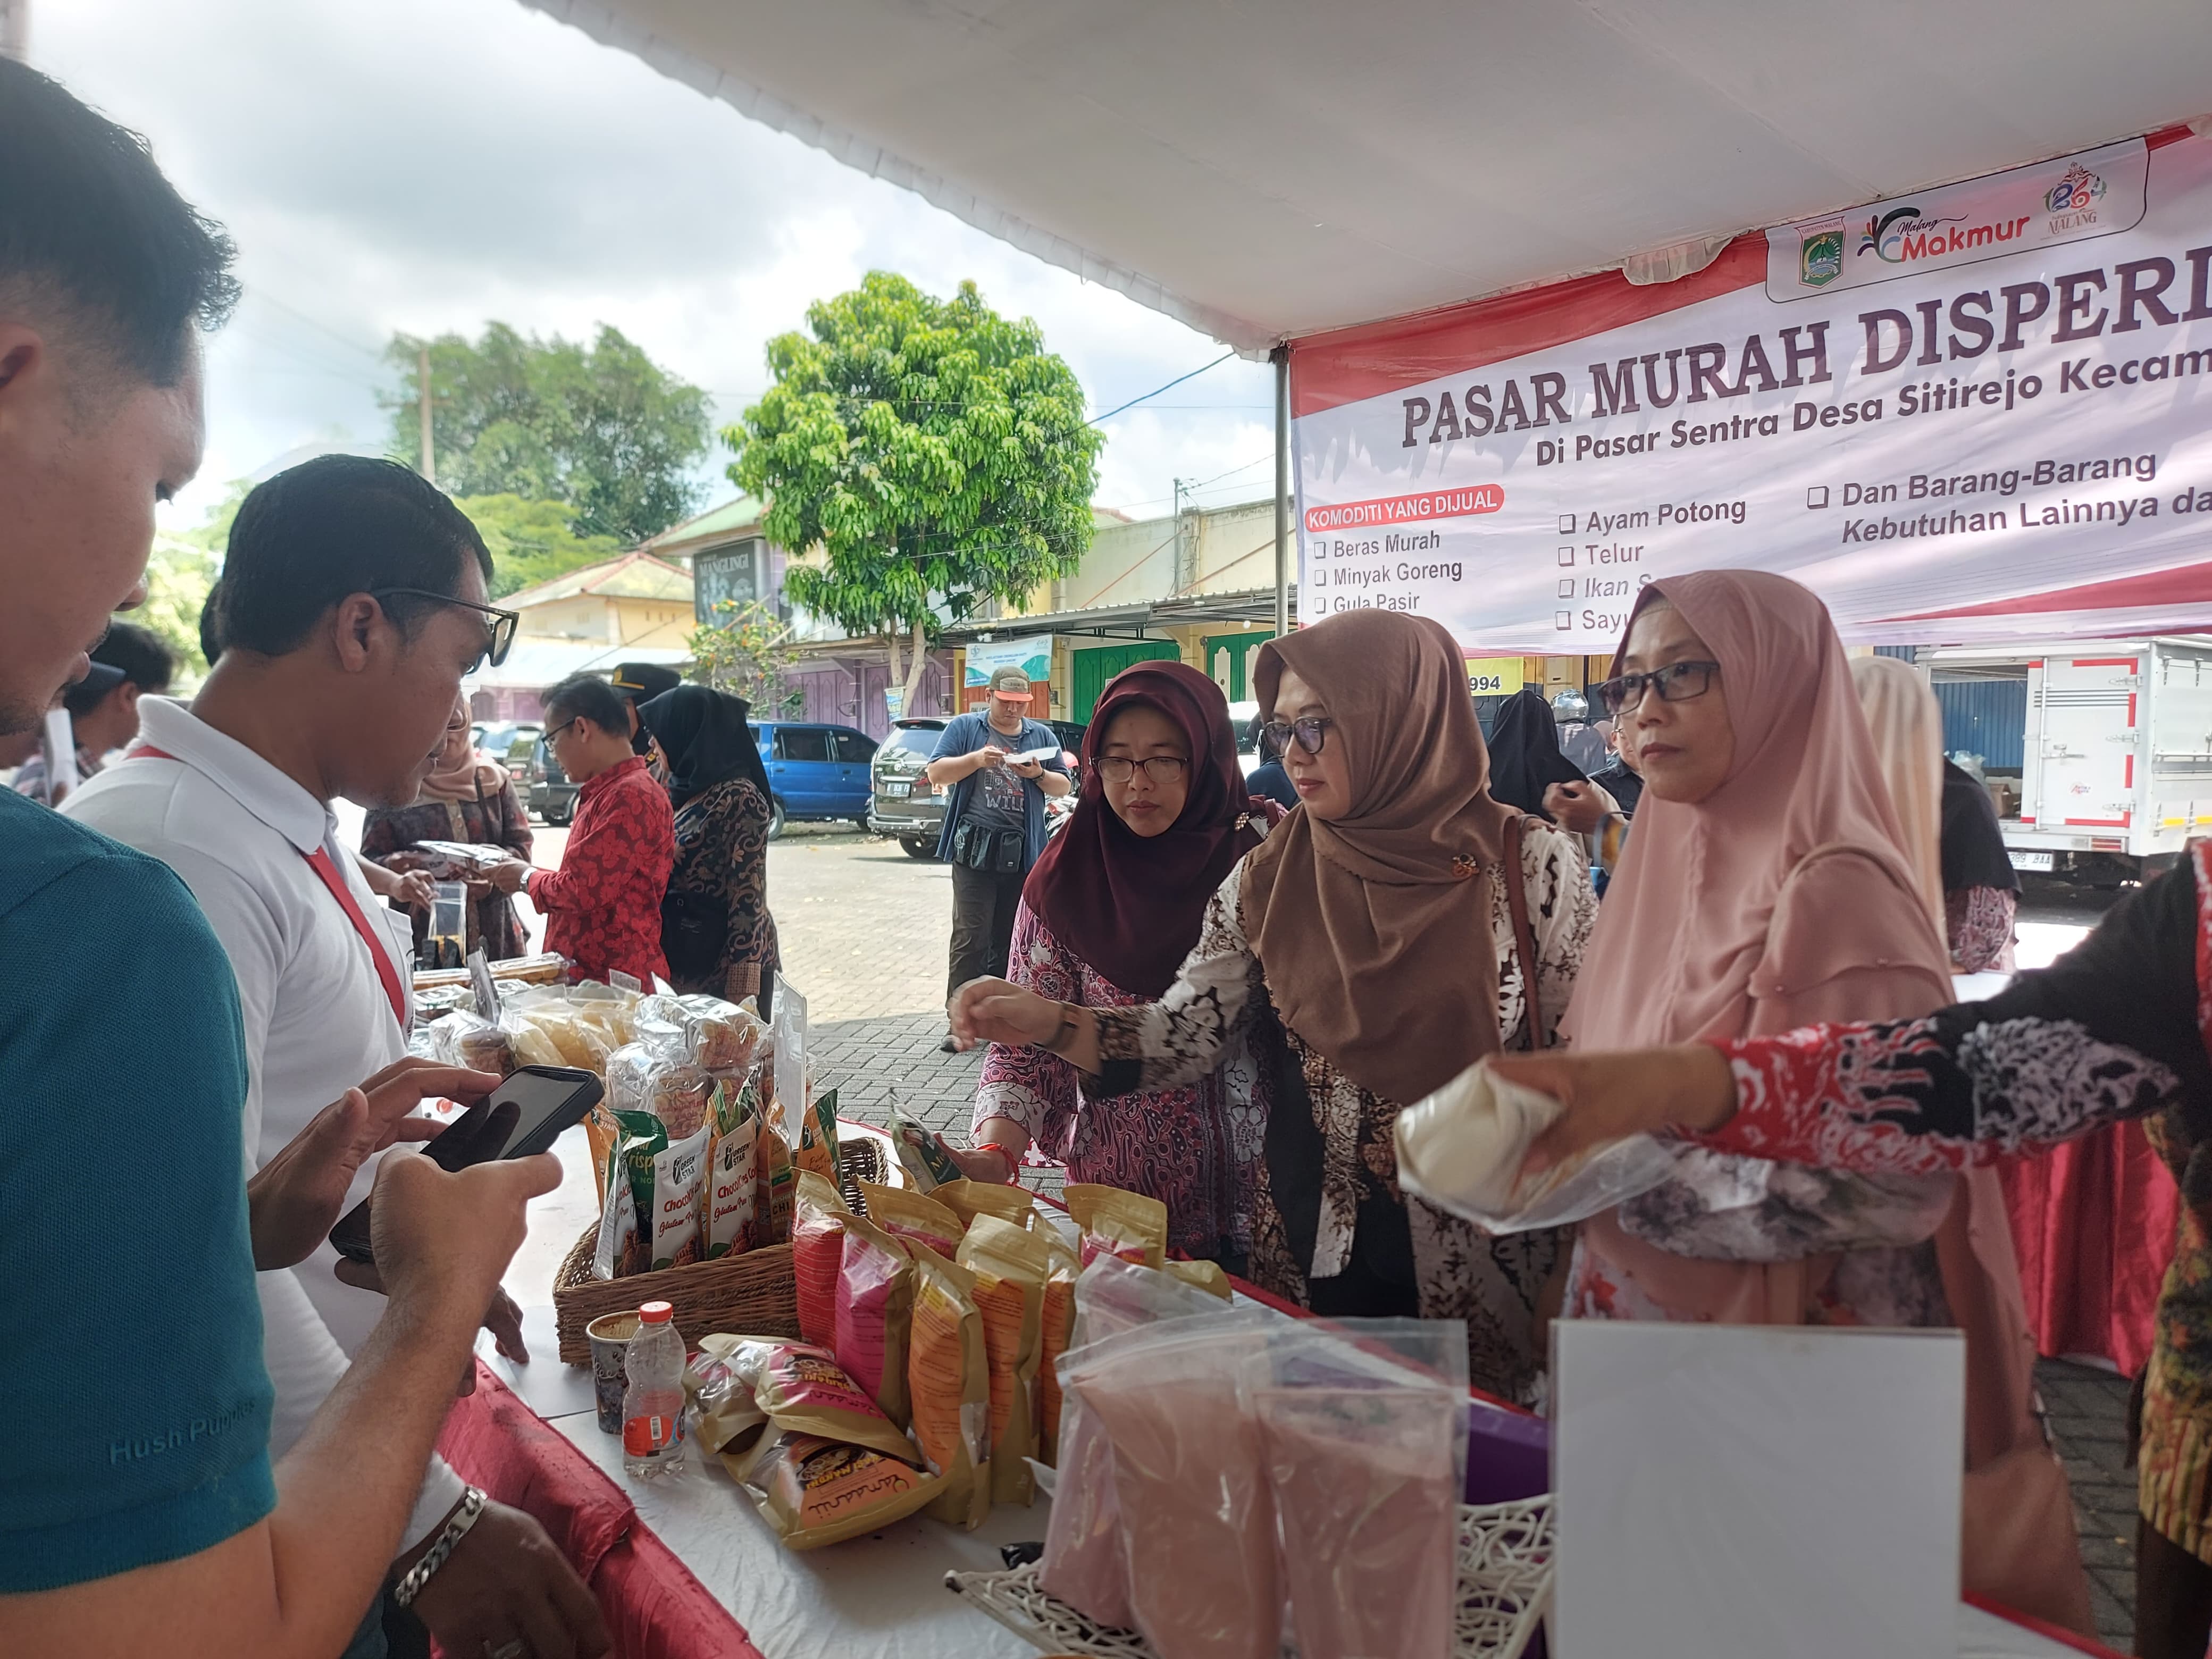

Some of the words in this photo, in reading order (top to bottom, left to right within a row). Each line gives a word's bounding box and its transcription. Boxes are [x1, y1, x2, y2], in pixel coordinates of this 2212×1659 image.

[1897, 215, 1954, 236] Malang
[2048, 212, 2097, 234] MALANG
[1901, 216, 2030, 262] Makmur
[1402, 372, 1572, 448] PASAR
[1589, 321, 1832, 418] MURAH
[1537, 438, 1564, 466] Di
[1576, 431, 1661, 461] Pasar
[1670, 414, 1779, 448] Sentra
[1793, 399, 1883, 431] Desa
[1897, 368, 2042, 416] Sitirejo
[2060, 348, 2212, 393] Kecam
[1842, 482, 1897, 506] Dan
[1908, 453, 2157, 500] Barang-Barang
[1309, 503, 1381, 528] KOMODITI
[1385, 497, 1431, 519] YANG
[1436, 490, 1497, 514] DIJUAL
[1586, 511, 1648, 537] Ayam
[1657, 501, 1746, 526] Potong
[1841, 509, 2007, 543] Kebutuhan
[2020, 496, 2159, 527] Lainnya
[1334, 540, 1379, 558] Beras
[1386, 530, 1440, 553] Murah
[1585, 543, 1644, 565] Telur
[1334, 565, 1391, 588] Minyak
[1397, 562, 1462, 581] Goreng
[1585, 577, 1629, 598] Ikan
[1377, 592, 1420, 611] Pasir
[1470, 675, 1501, 691] 994
[733, 1142, 750, 1157] GREEN
[733, 1152, 745, 1166] STAR
[680, 1155, 696, 1170] GREEN
[681, 1165, 696, 1179] STAR
[714, 1203, 738, 1224] Gluten
[658, 1218, 684, 1238] Gluten
[109, 1429, 183, 1465] Hush
